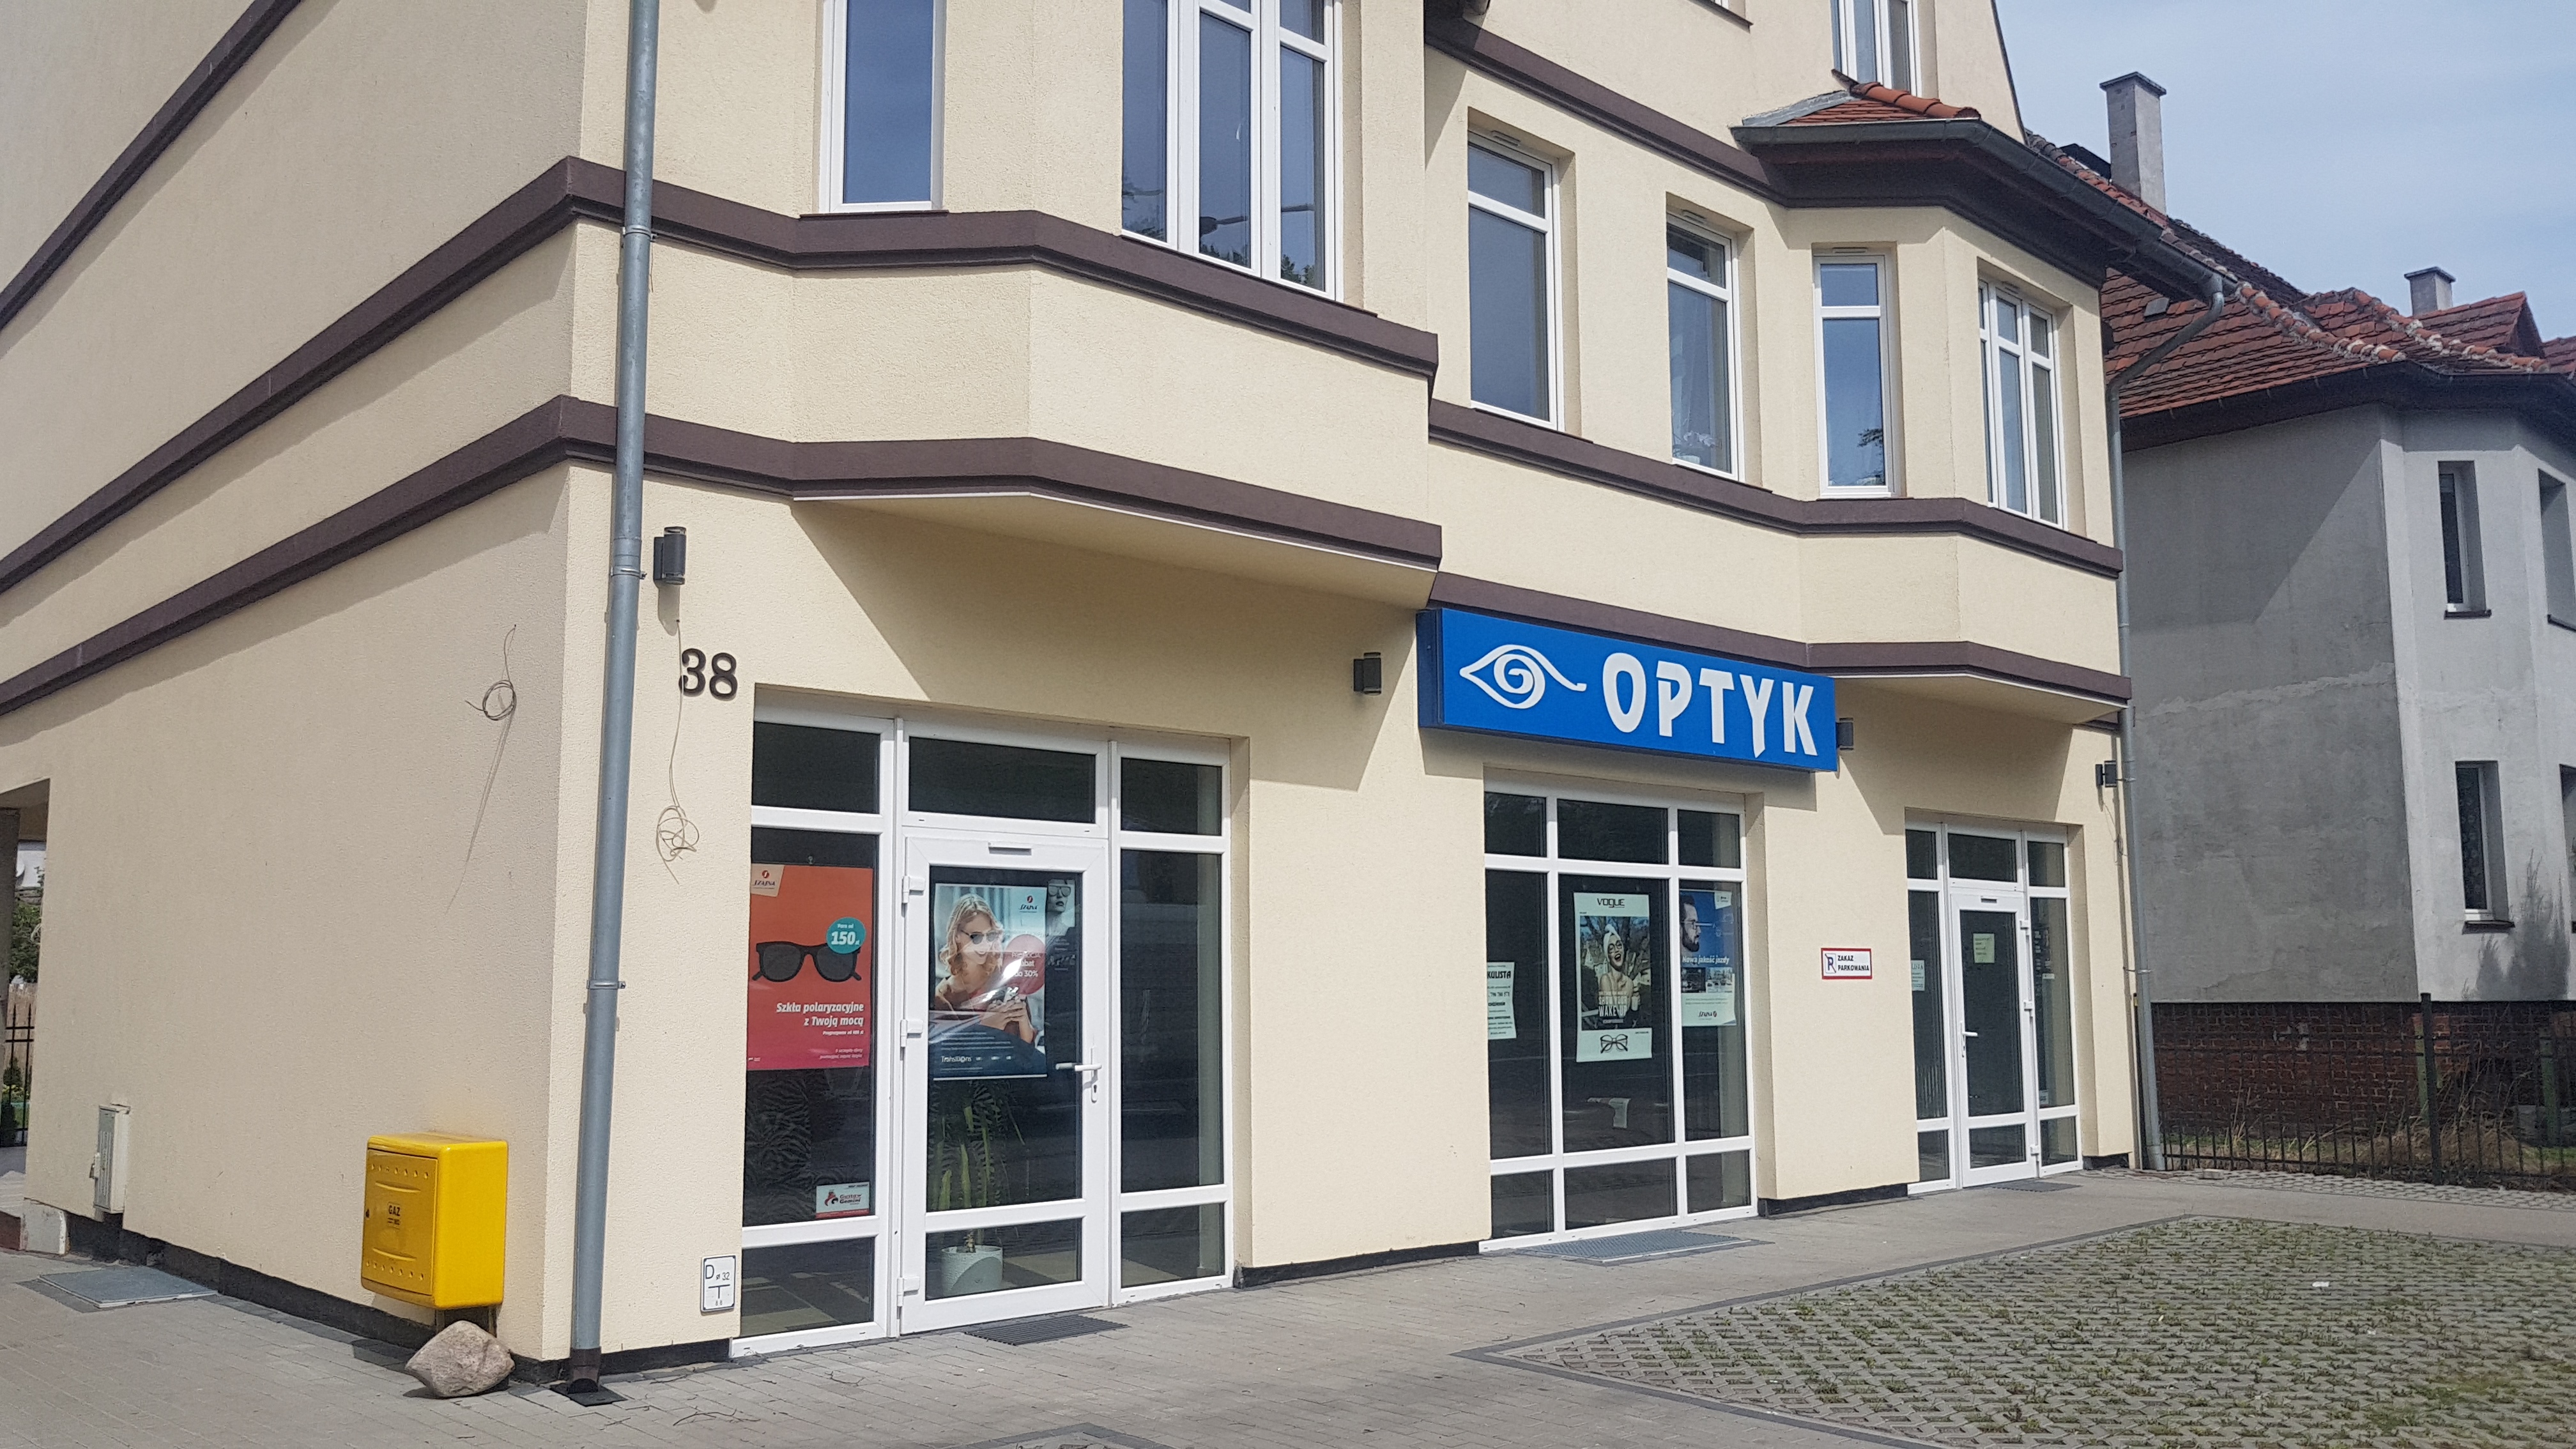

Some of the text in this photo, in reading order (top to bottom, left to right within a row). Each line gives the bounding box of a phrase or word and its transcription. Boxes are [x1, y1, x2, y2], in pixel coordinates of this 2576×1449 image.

[679, 648, 738, 701] 38
[1602, 652, 1818, 758] OPTYK
[1597, 898, 1625, 908] VOGUE
[776, 1001, 864, 1014] Szkła polaryzacyjne
[1598, 1005, 1616, 1017] WAKE
[804, 1015, 864, 1027] z Twoją mocą
[388, 1205, 401, 1216] GAZ
[705, 1265, 714, 1279] D
[722, 1271, 730, 1280] 32
